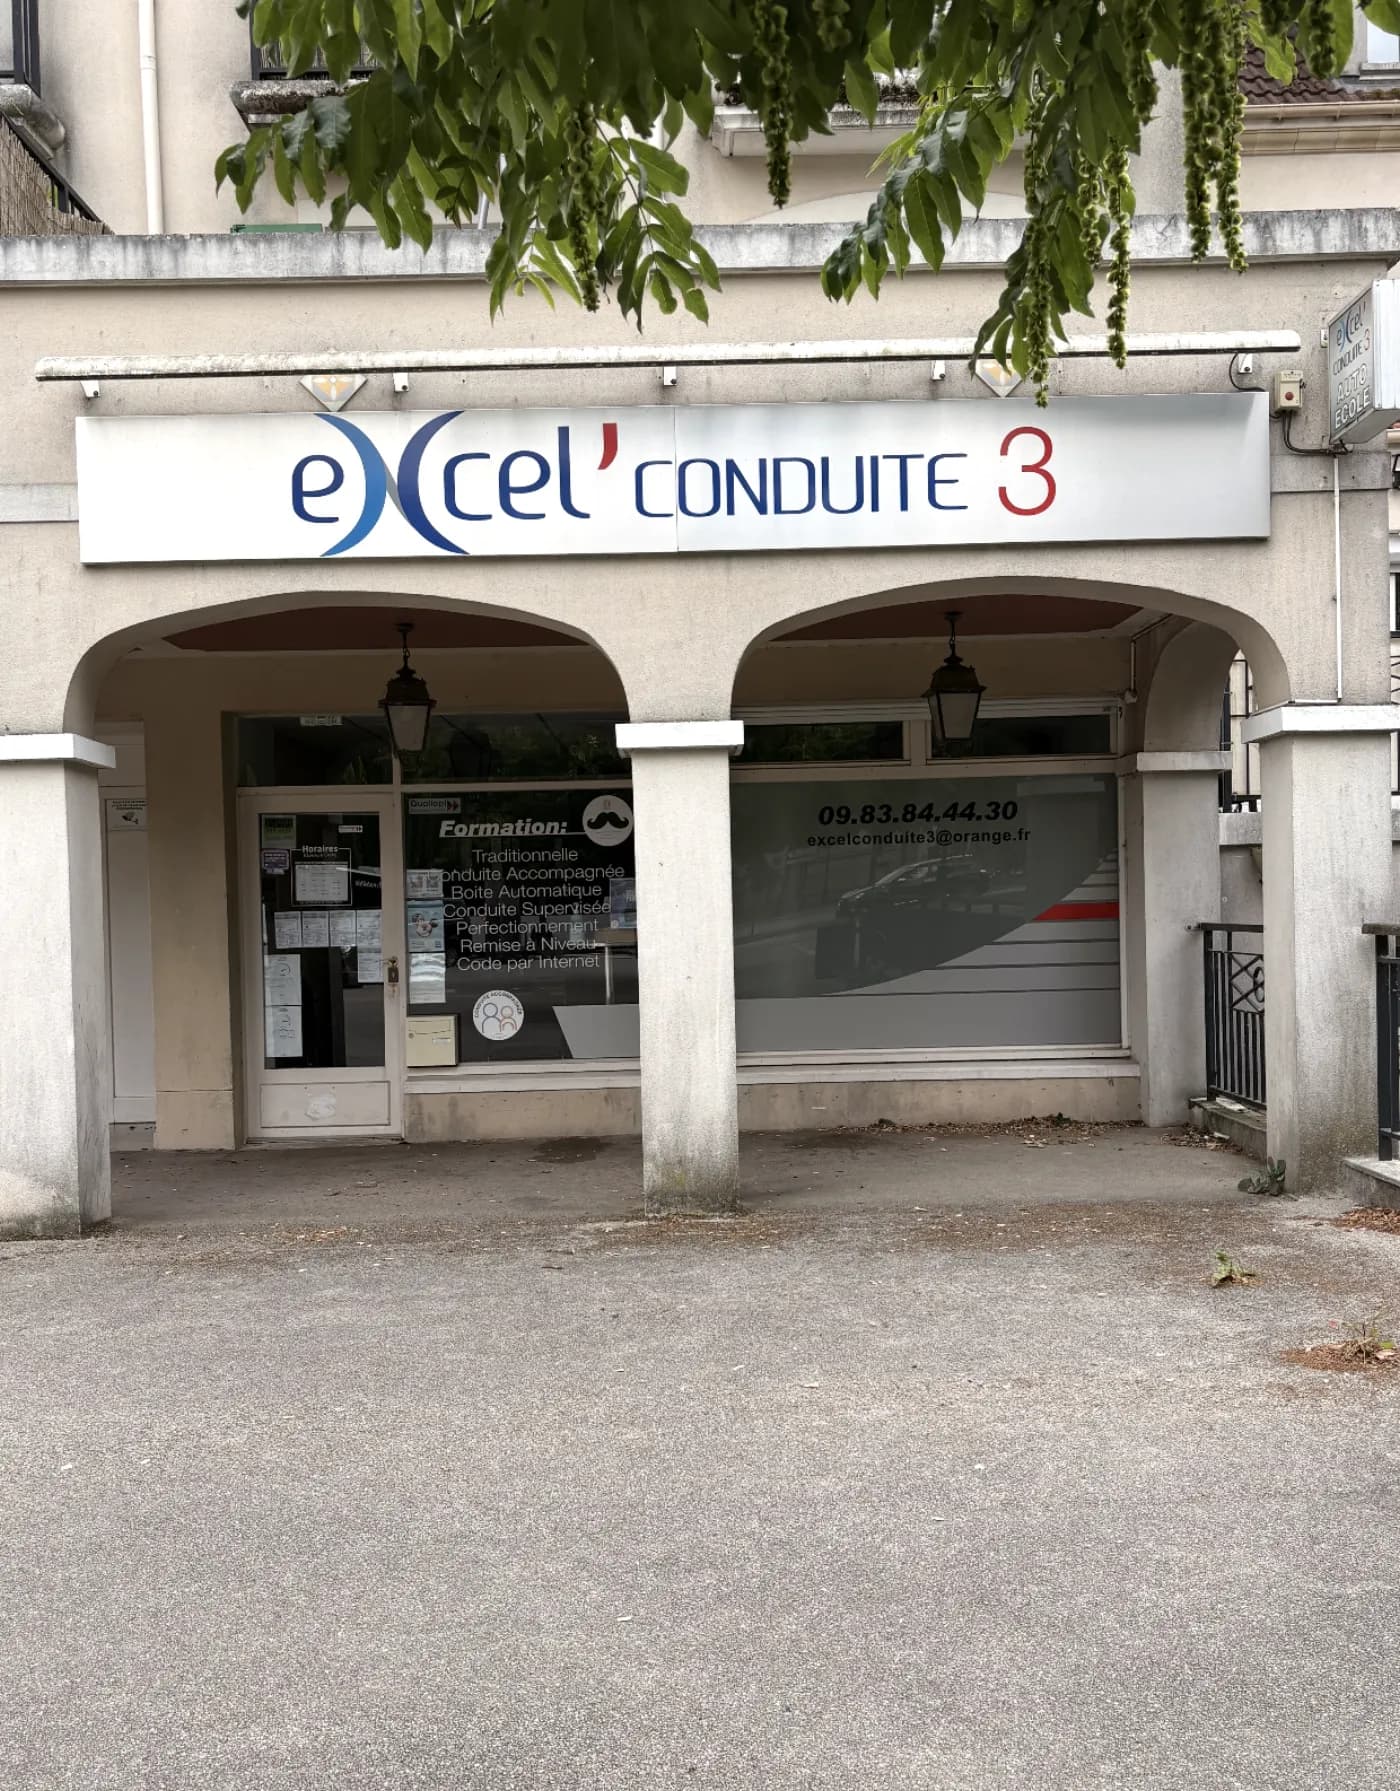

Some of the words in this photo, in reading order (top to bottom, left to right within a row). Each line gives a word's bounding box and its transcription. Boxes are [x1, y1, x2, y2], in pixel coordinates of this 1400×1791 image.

[1333, 342, 1363, 376] CONDUITE
[1363, 328, 1371, 352] 3
[1336, 362, 1368, 405] AUTO
[1335, 385, 1371, 429] ECOLE
[635, 453, 968, 518] CONDUITE
[998, 426, 1057, 516] 3
[818, 800, 1018, 826] 09.83.84.44.30
[439, 819, 568, 838] Formation:
[807, 828, 1032, 847] excelconduite3@orange.fr
[302, 844, 339, 854] Horaires
[472, 848, 579, 864] Traditionnelle
[506, 864, 625, 884] Accompagnée
[451, 885, 494, 900] Boite
[498, 883, 602, 899] Automatique
[443, 902, 517, 918] Conduite
[522, 900, 611, 917] Supervisée
[456, 919, 599, 935] Perfectionnement
[460, 939, 524, 953] Remise
[526, 938, 536, 951] à
[541, 936, 597, 951] Niveau
[457, 955, 502, 971] Code
[507, 958, 534, 972] par
[539, 954, 601, 969] Internet
